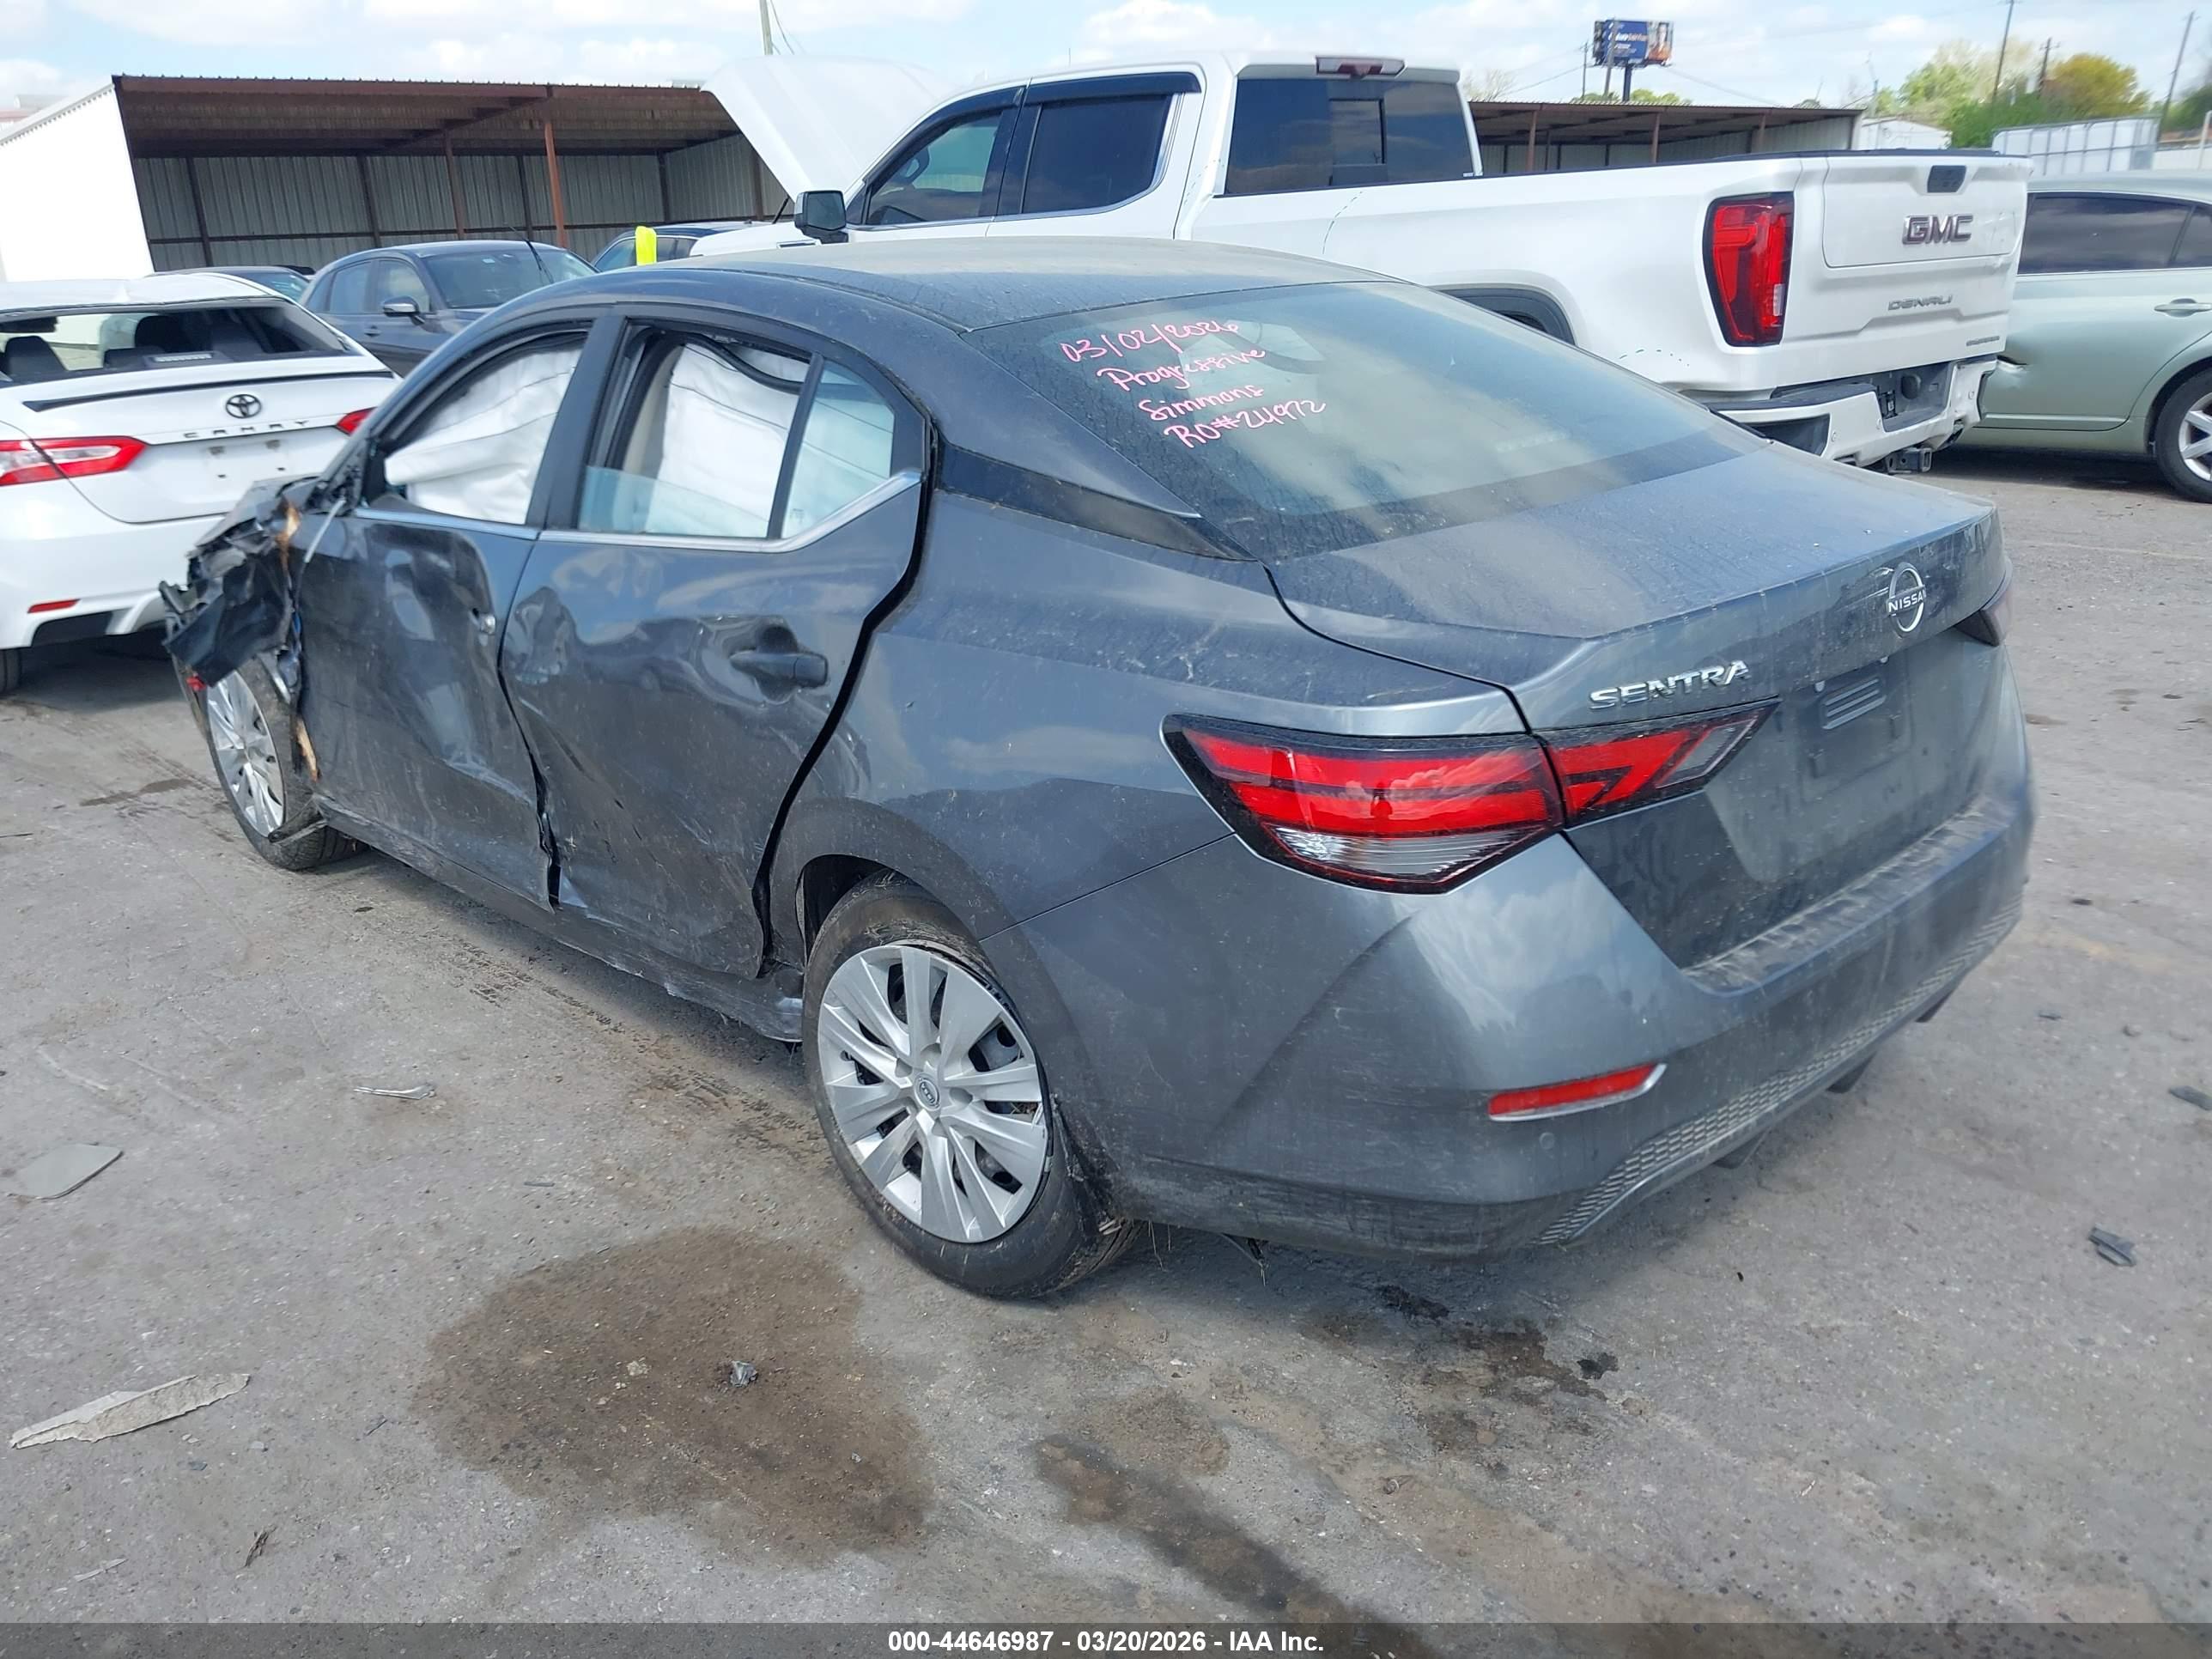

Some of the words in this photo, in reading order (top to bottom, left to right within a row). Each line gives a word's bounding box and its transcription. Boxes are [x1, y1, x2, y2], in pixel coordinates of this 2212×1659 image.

[1903, 215, 1974, 245] GMC
[1888, 294, 1954, 311] DENALI
[1060, 319, 1239, 362] 03/02/2026
[1096, 349, 1266, 392] Progressive
[1138, 385, 1265, 421] Simmons
[183, 420, 309, 439] CAMRY
[1589, 659, 1752, 710] SENTRA
